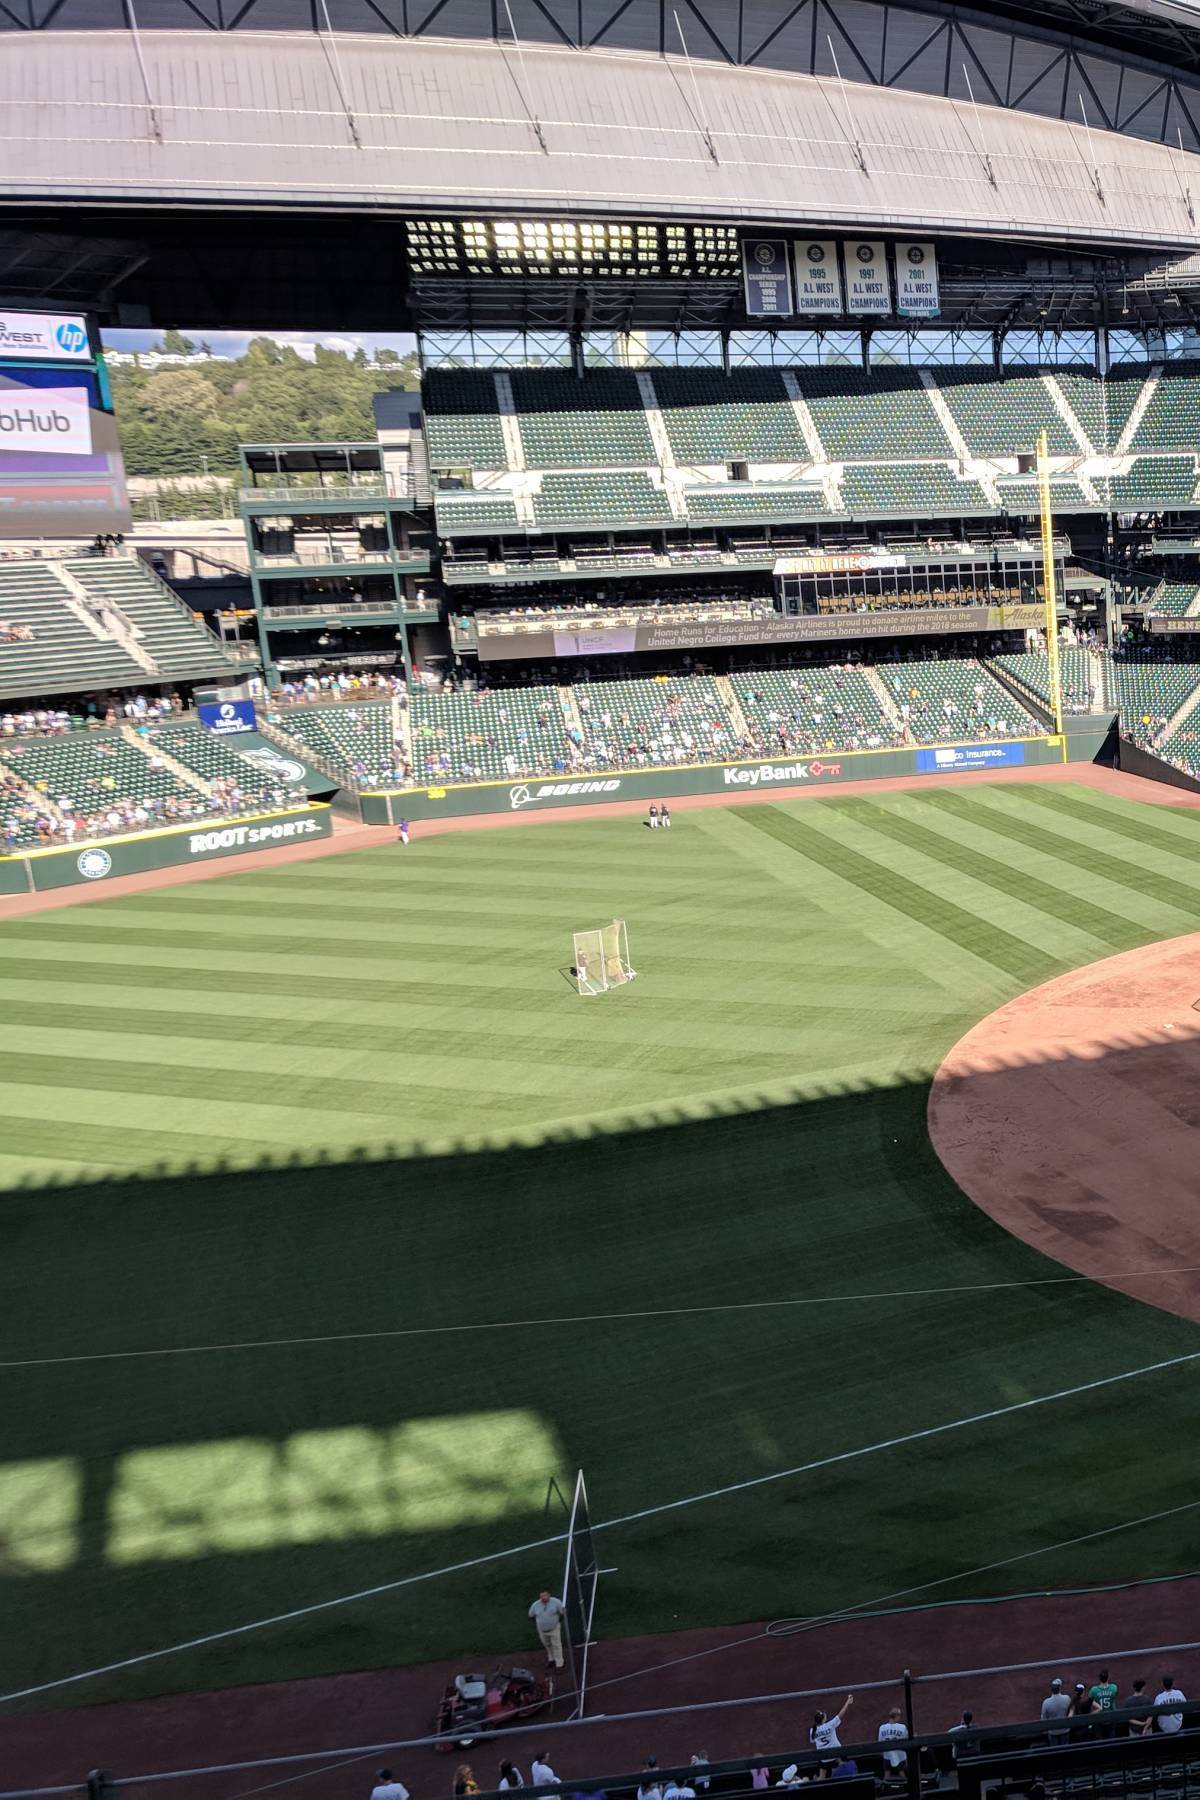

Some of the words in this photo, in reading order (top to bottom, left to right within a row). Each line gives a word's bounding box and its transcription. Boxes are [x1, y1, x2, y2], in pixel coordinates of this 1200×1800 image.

[808, 268, 826, 279] 1995
[858, 268, 875, 279] 1997
[908, 268, 925, 279] 2001
[816, 282, 834, 293] WEST
[865, 283, 883, 293] WEST
[915, 283, 932, 293] WEST
[800, 297, 840, 308] CHAMPIONS
[850, 297, 889, 308] CHAMPIONS
[900, 296, 937, 308] CHAMPIONS
[1004, 607, 1044, 621] Alaska
[654, 627, 679, 637] Home
[681, 626, 702, 636] Runs
[704, 625, 716, 634] for
[718, 624, 759, 634] Education
[766, 621, 794, 631] Alaska
[795, 620, 826, 630] Airlines
[837, 617, 861, 628] proud
[862, 617, 870, 625] to
[872, 616, 898, 625] donate
[900, 613, 925, 623] airline
[926, 612, 948, 622] miles
[949, 612, 957, 621] to
[958, 612, 971, 620] the
[647, 635, 677, 647] United
[678, 634, 704, 647] Negro
[705, 633, 737, 645] College
[738, 631, 760, 641] Fund
[761, 631, 773, 640] for
[776, 630, 799, 641] every
[800, 627, 837, 638] Mariners
[838, 626, 861, 635] home
[862, 625, 877, 633] run
[878, 624, 888, 633] hit
[890, 621, 915, 633] during
[917, 621, 929, 631] the
[931, 620, 950, 630] 2018
[951, 620, 978, 629] season
[723, 761, 809, 786] KeyBank
[537, 779, 621, 797] BOEING
[189, 826, 249, 853] ROOT
[820, 1736, 830, 1747] 5
